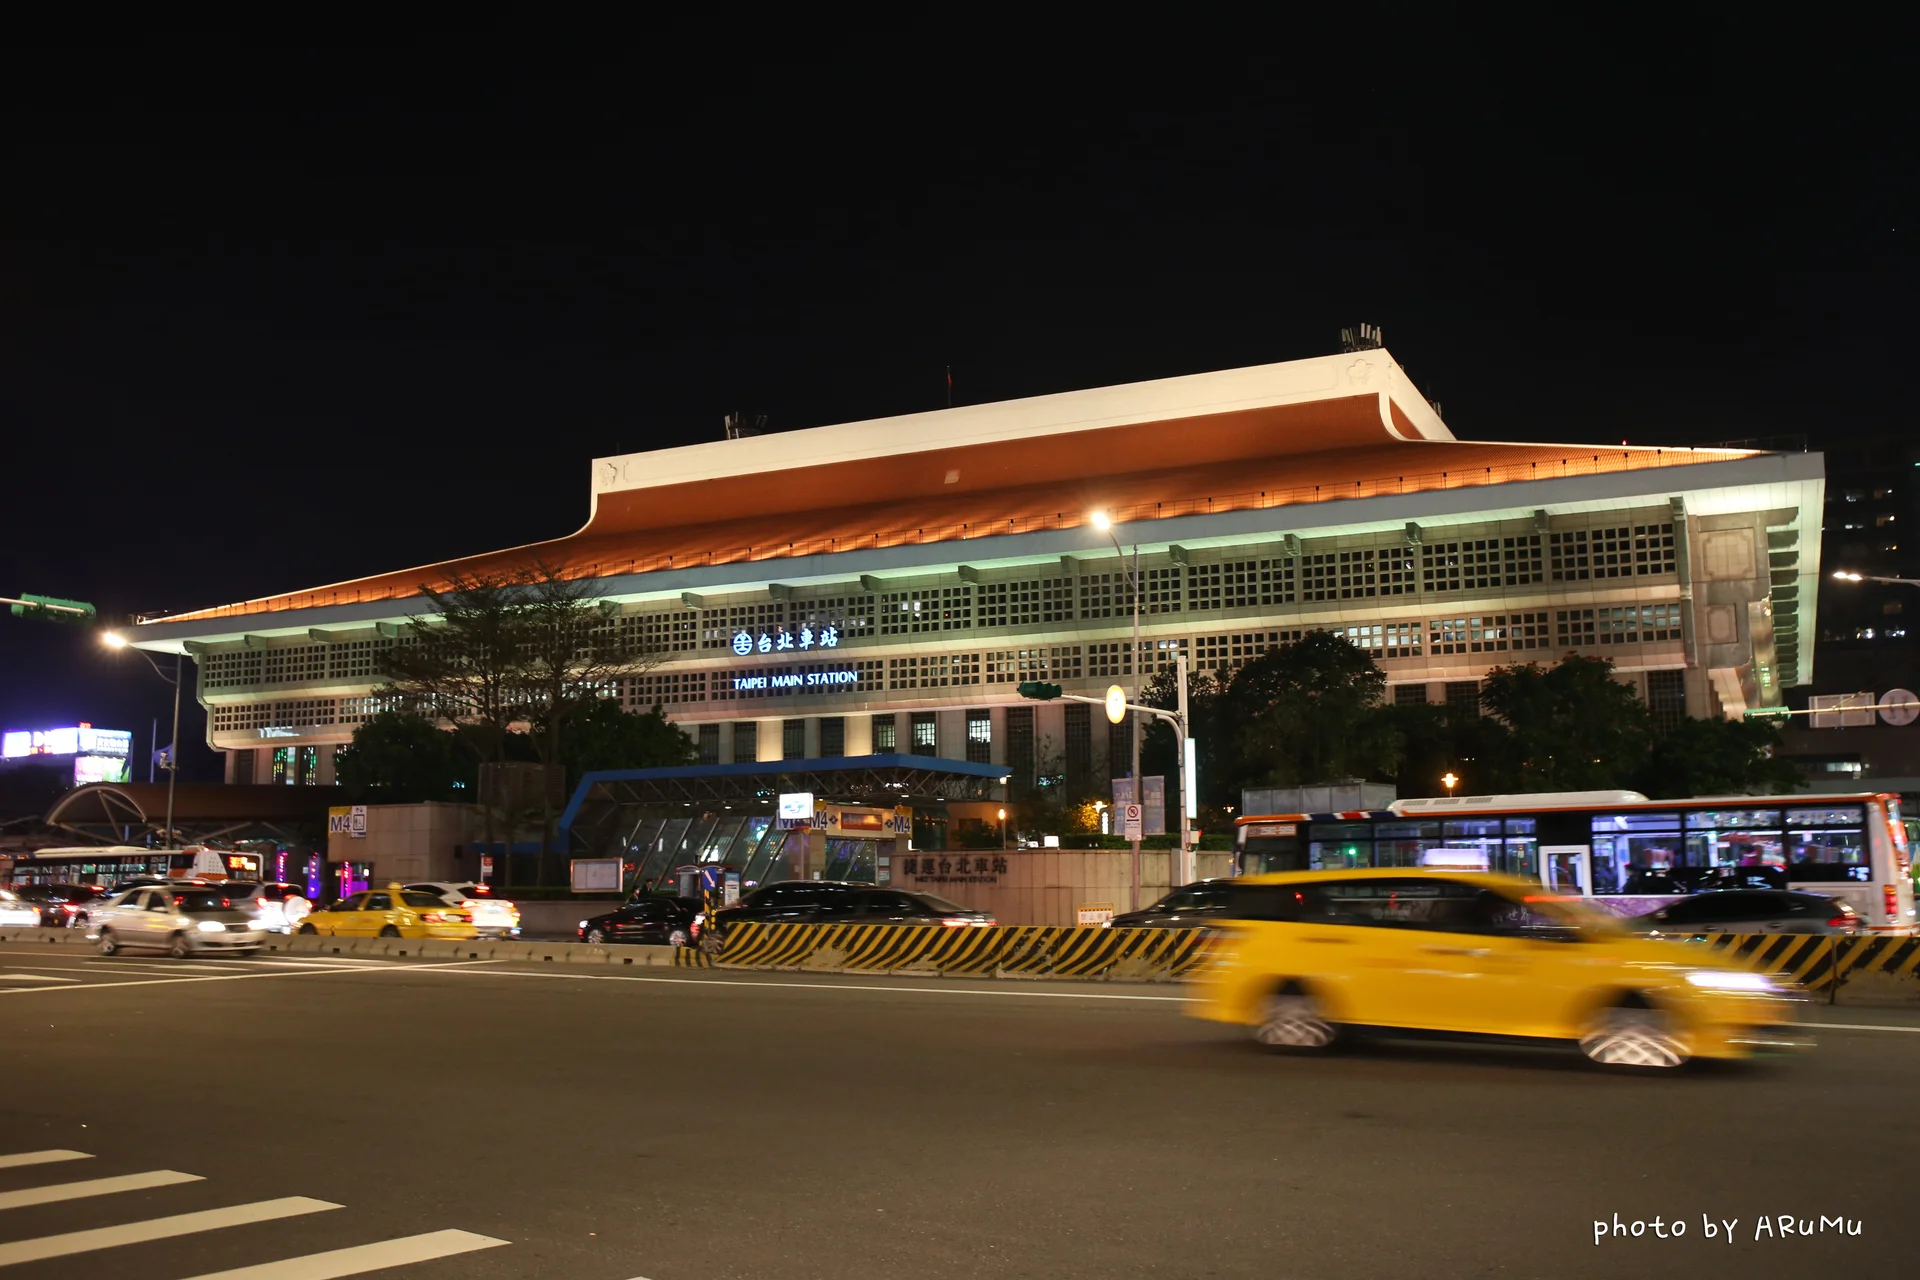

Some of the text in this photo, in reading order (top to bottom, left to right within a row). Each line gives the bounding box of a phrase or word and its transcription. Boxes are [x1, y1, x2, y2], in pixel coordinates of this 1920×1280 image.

[756, 626, 839, 654] 台北車站
[733, 670, 858, 690] TAIPEI MAIN STATION
[330, 816, 351, 832] M4
[810, 811, 828, 829] M4
[893, 815, 911, 833] M4
